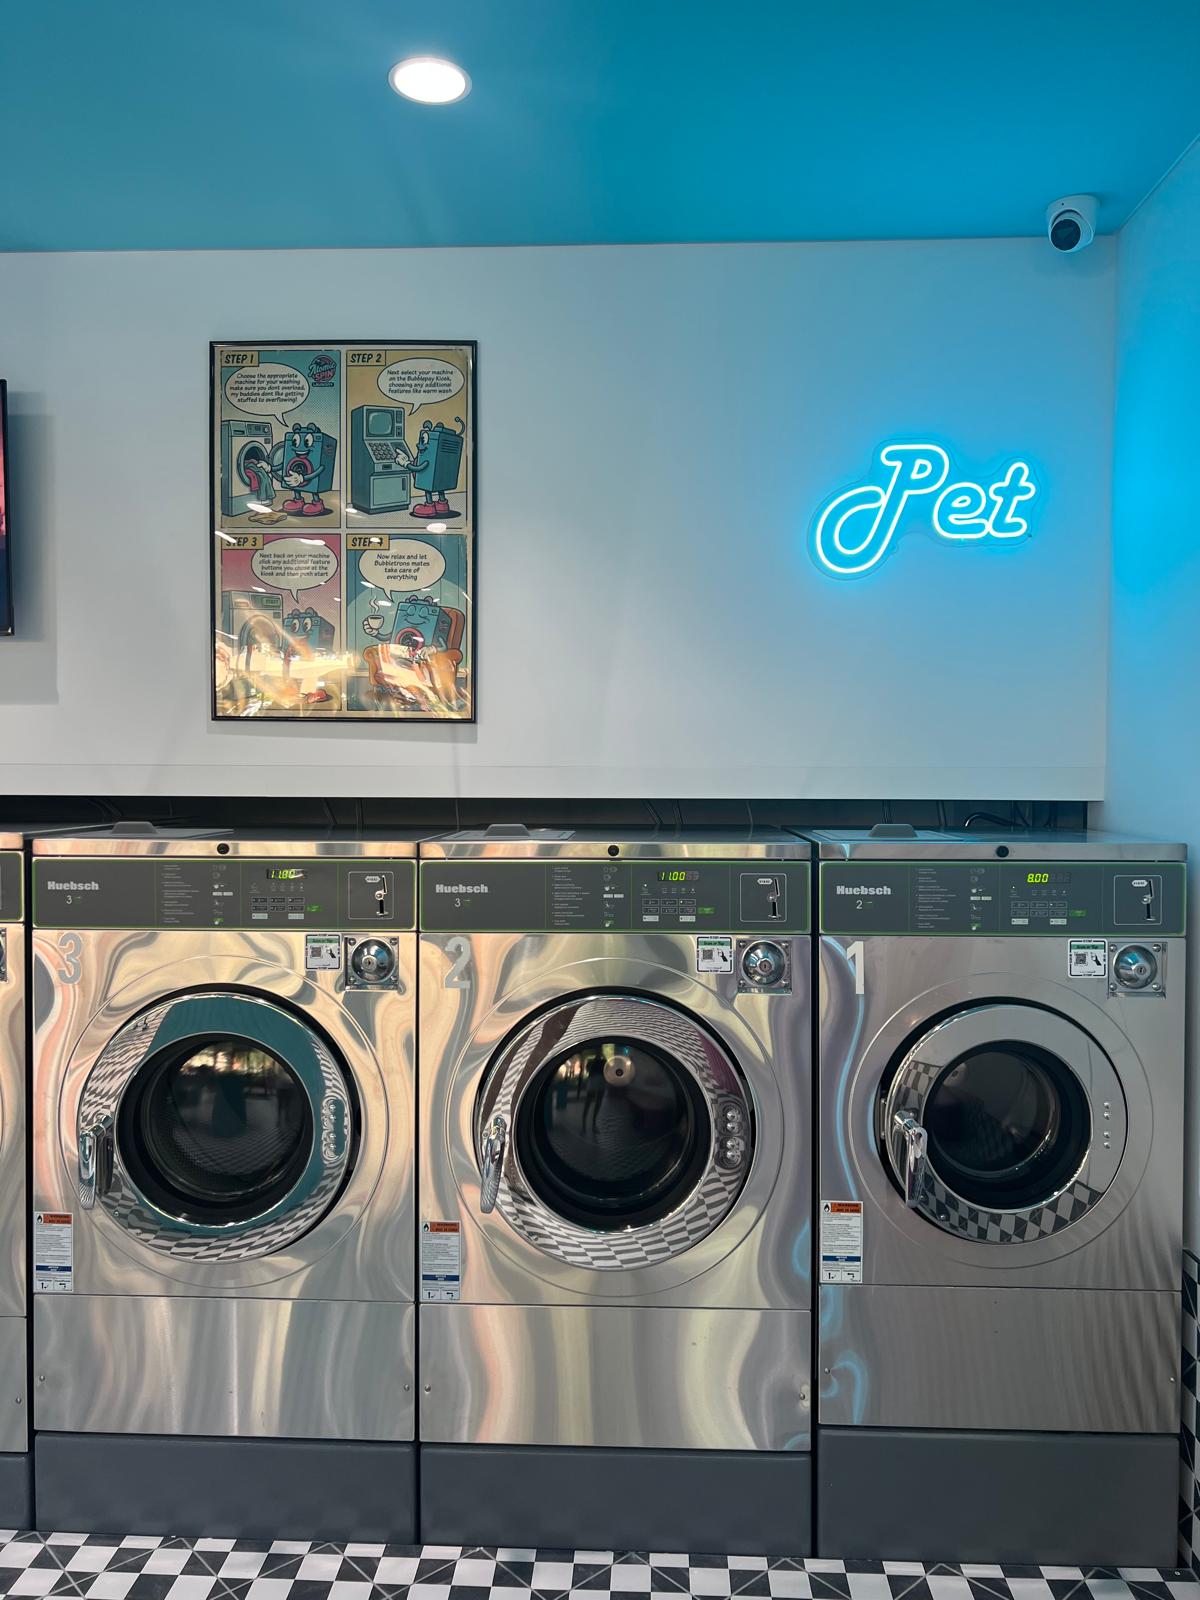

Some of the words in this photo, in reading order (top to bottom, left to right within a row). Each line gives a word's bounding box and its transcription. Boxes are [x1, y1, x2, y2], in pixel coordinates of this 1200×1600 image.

[224, 354, 247, 364] STEP
[250, 354, 254, 364] 1
[350, 354, 373, 363] STEP
[376, 354, 382, 363] 2
[816, 444, 1036, 573] Pet
[226, 536, 247, 546] STEP
[252, 536, 257, 546] 3
[48, 881, 99, 890] Huebsch
[435, 884, 488, 893] Huebsch
[836, 886, 892, 895] Huebsch
[66, 895, 72, 904] 3
[454, 898, 461, 907] 3
[856, 900, 863, 909] 2
[58, 932, 82, 984] 3
[445, 936, 470, 988] 2
[846, 941, 864, 994] 1
